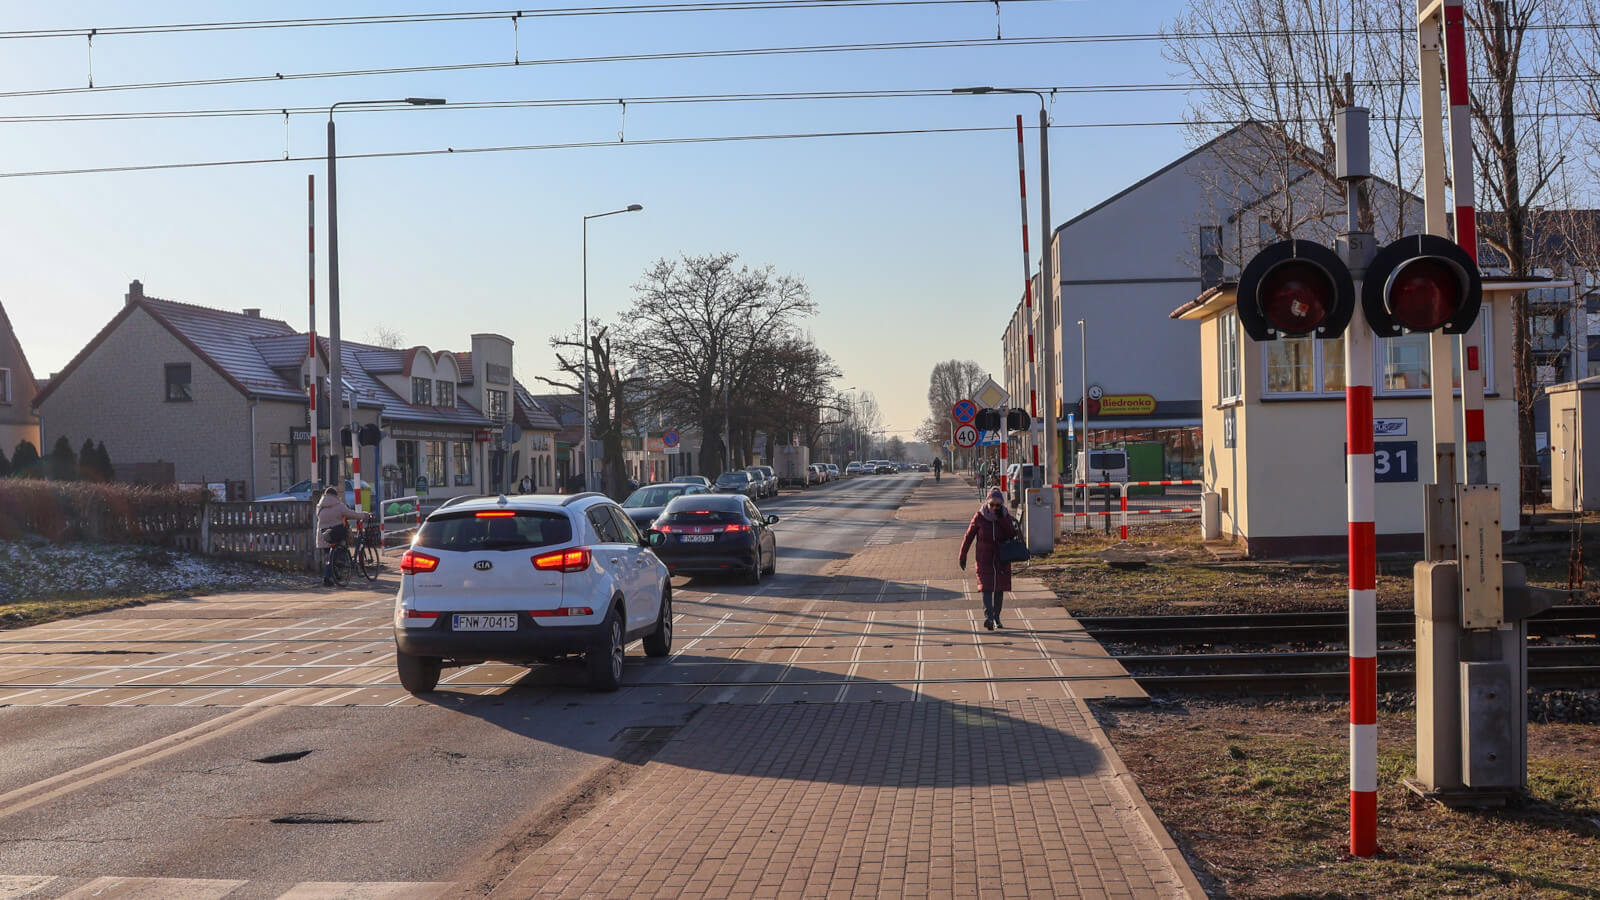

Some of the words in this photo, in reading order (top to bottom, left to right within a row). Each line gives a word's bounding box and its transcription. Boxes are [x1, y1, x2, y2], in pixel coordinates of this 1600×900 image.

[1103, 398, 1152, 407] Biedronka
[958, 431, 975, 442] 40
[1375, 449, 1407, 474] 31
[459, 616, 479, 628] FNW
[483, 615, 516, 628] 70415
